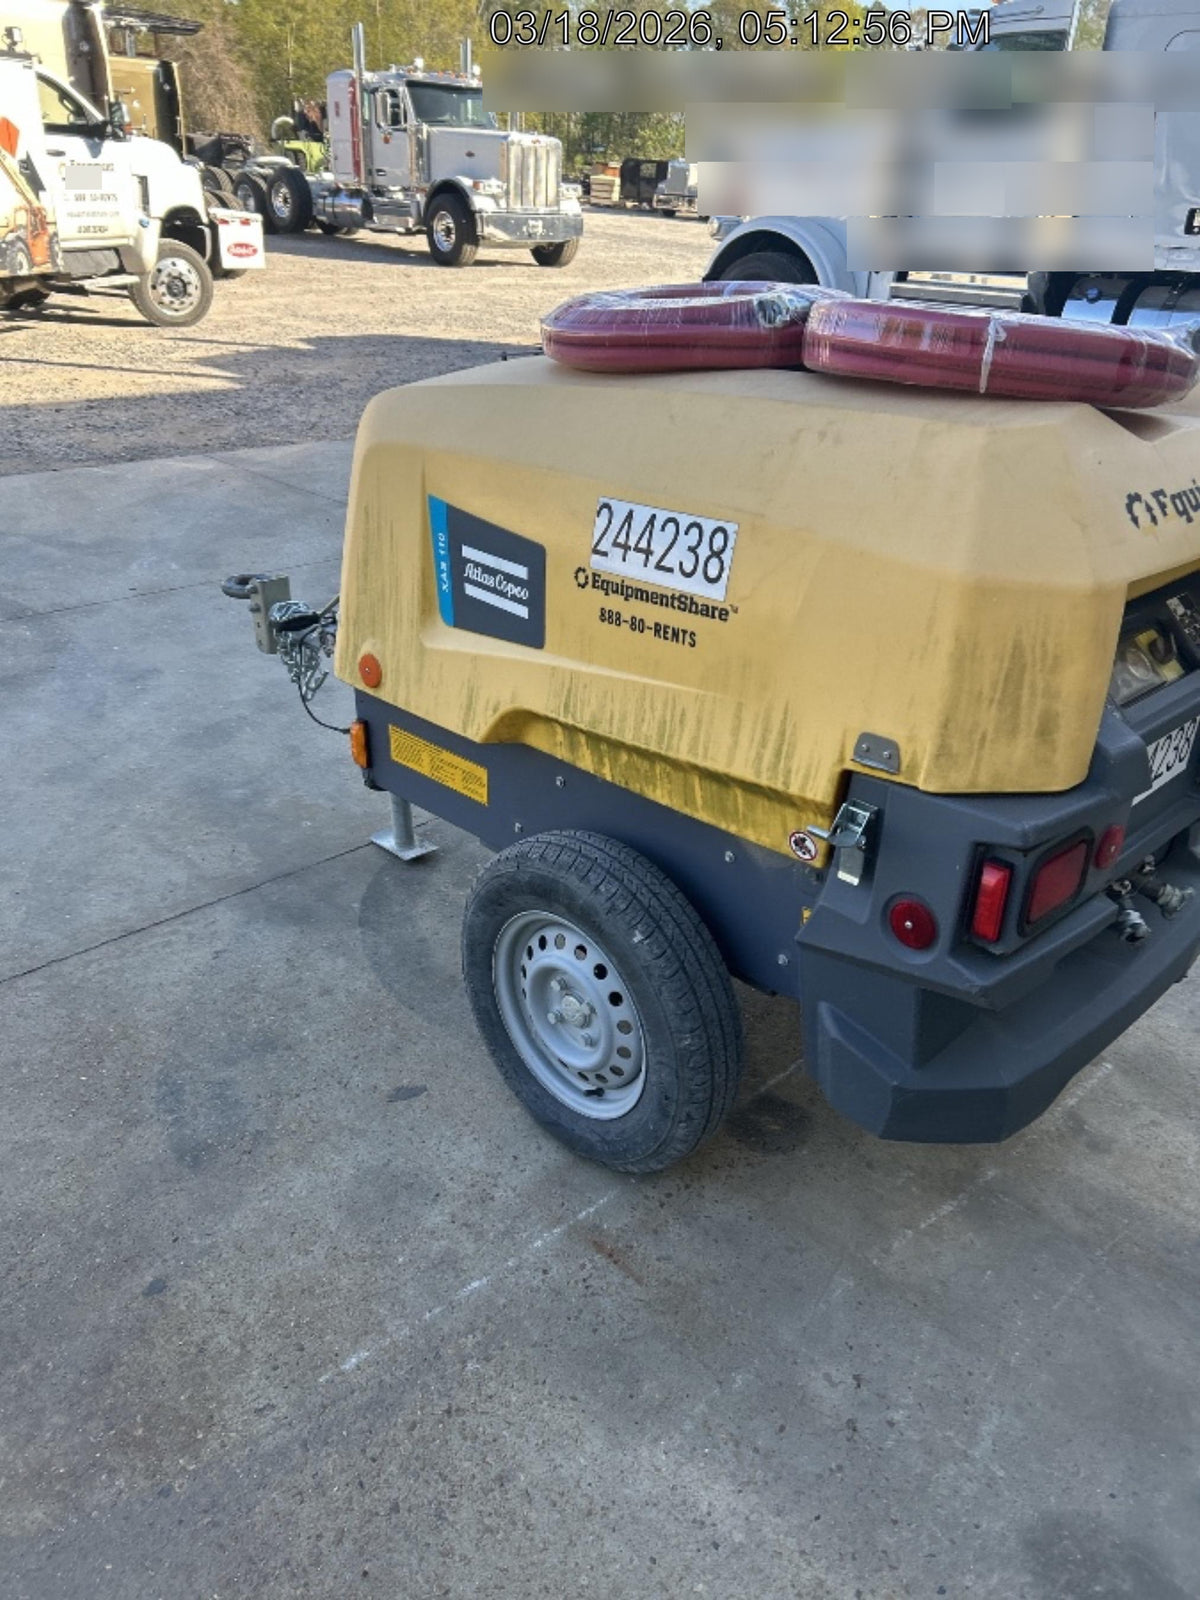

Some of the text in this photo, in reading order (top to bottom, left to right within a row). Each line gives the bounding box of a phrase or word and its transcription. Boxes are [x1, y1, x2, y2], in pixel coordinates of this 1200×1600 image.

[438, 532, 446, 555] 110
[592, 502, 729, 584] 244238
[591, 572, 730, 622] EquipmentShare
[599, 607, 697, 648] 888-80-RENTS
